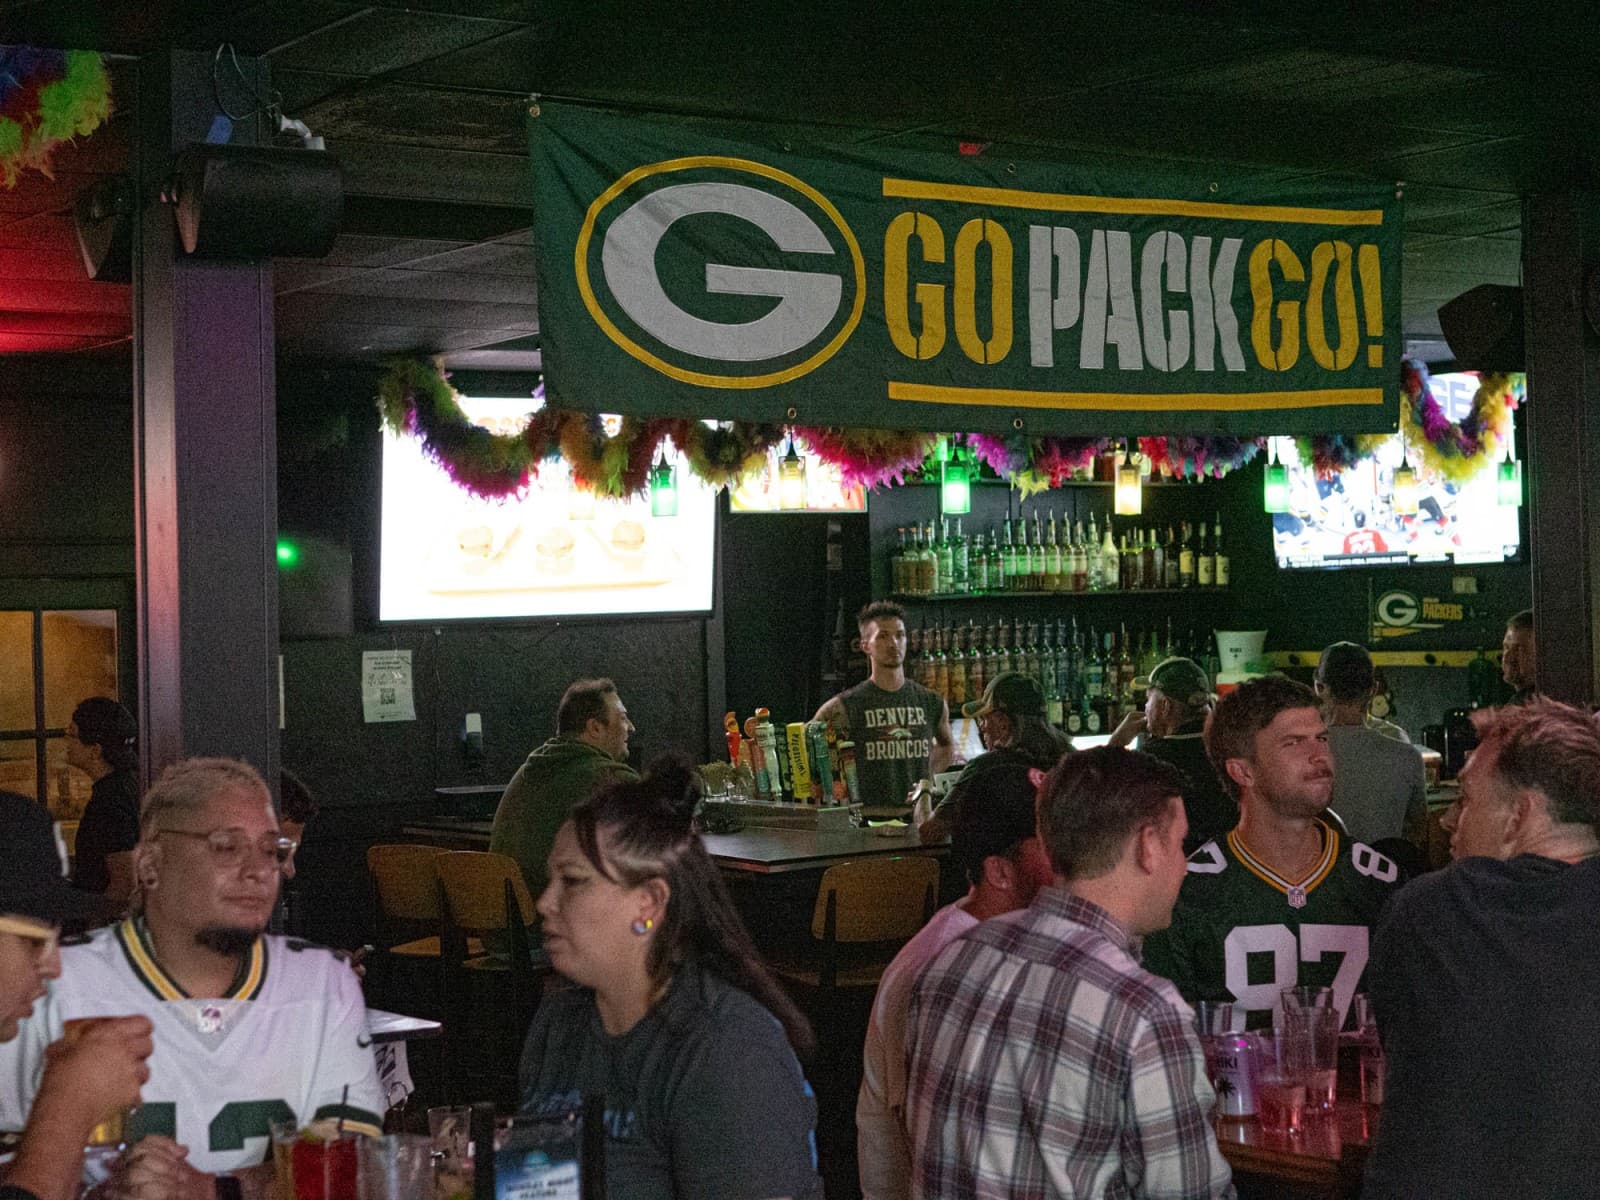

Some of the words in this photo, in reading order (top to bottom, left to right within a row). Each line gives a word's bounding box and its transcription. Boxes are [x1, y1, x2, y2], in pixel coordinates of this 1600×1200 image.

[602, 182, 843, 362] G
[884, 211, 1014, 365] GO
[1028, 225, 1247, 373] PACK
[1248, 238, 1384, 372] GO!
[865, 706, 927, 729] DENVER
[865, 739, 929, 761] BRONCOS
[1352, 842, 1399, 884] 8
[1224, 923, 1370, 1034] 87
